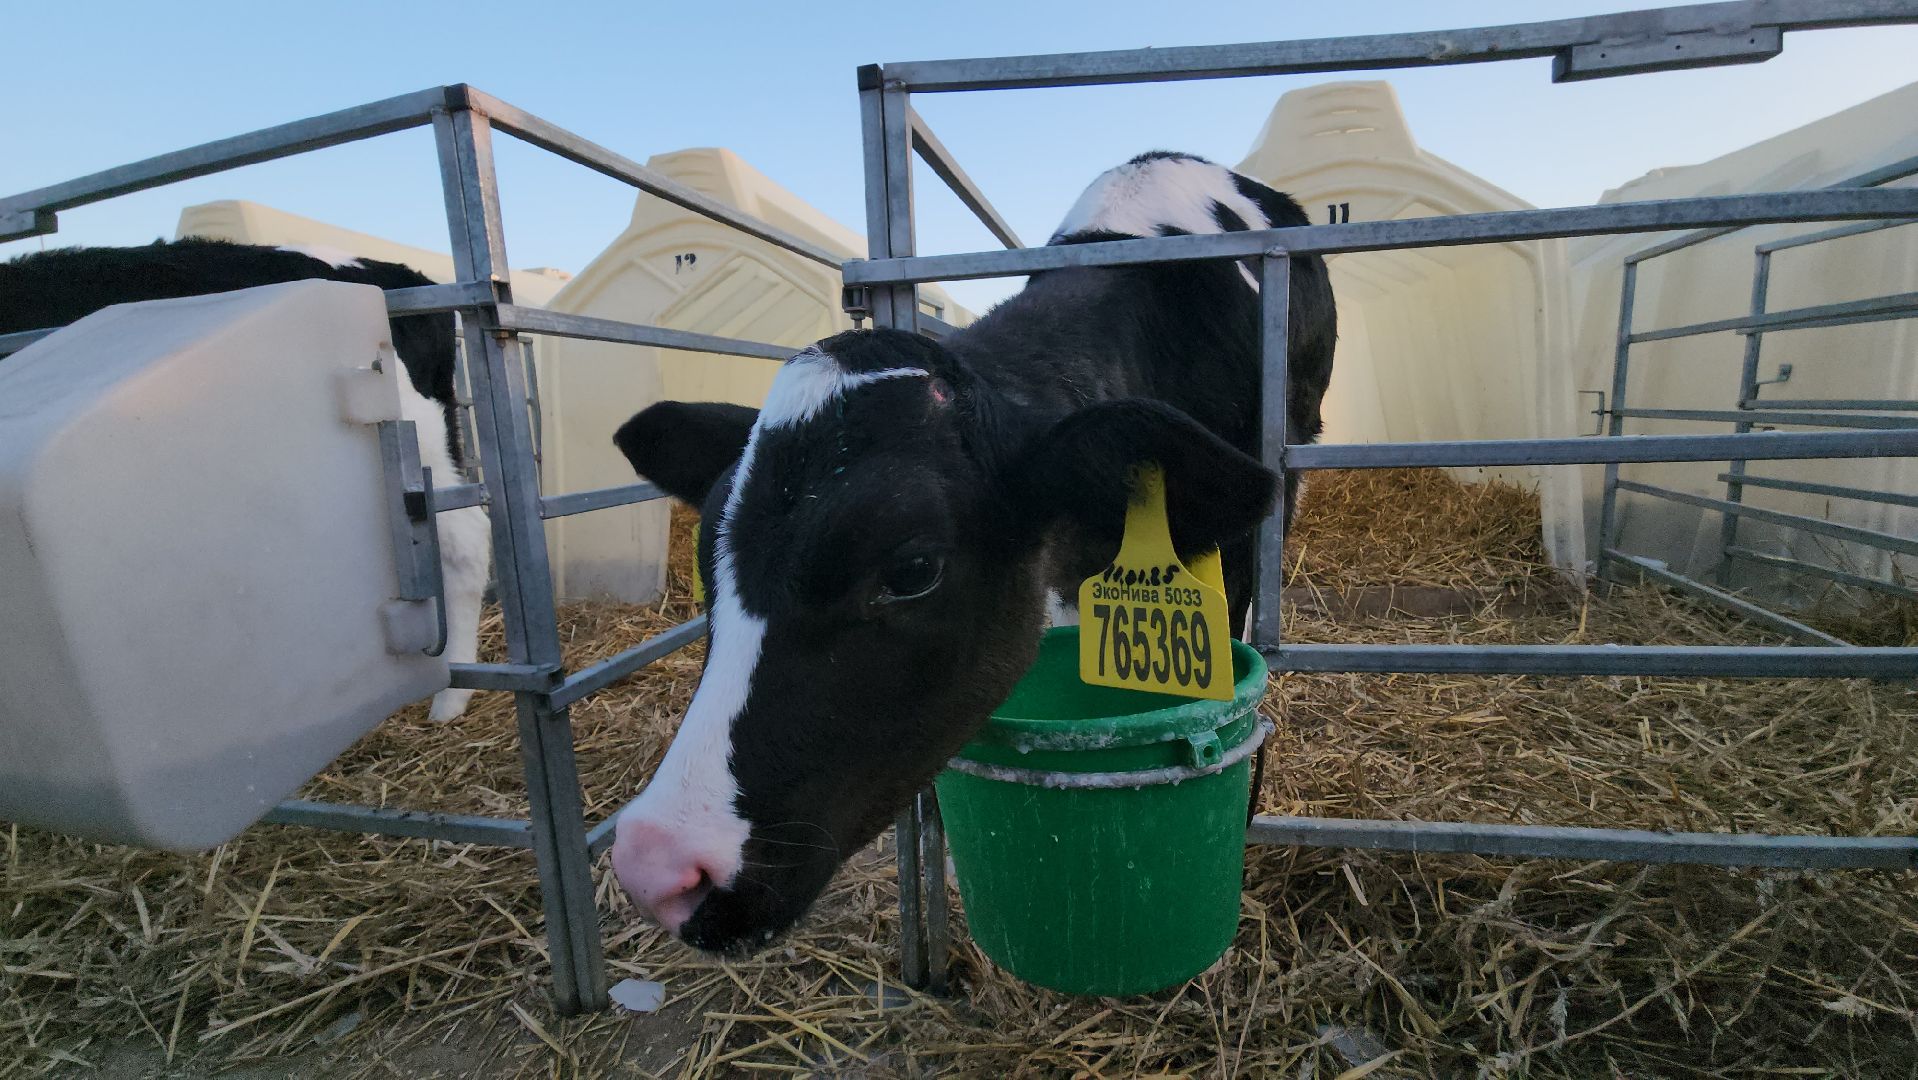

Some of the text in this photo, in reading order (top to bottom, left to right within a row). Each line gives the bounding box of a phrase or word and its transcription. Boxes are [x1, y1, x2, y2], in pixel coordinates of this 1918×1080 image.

[1328, 203, 1349, 225] 11
[1092, 582, 1203, 607] ЭкоНива 5033
[1093, 604, 1212, 689] 765369
